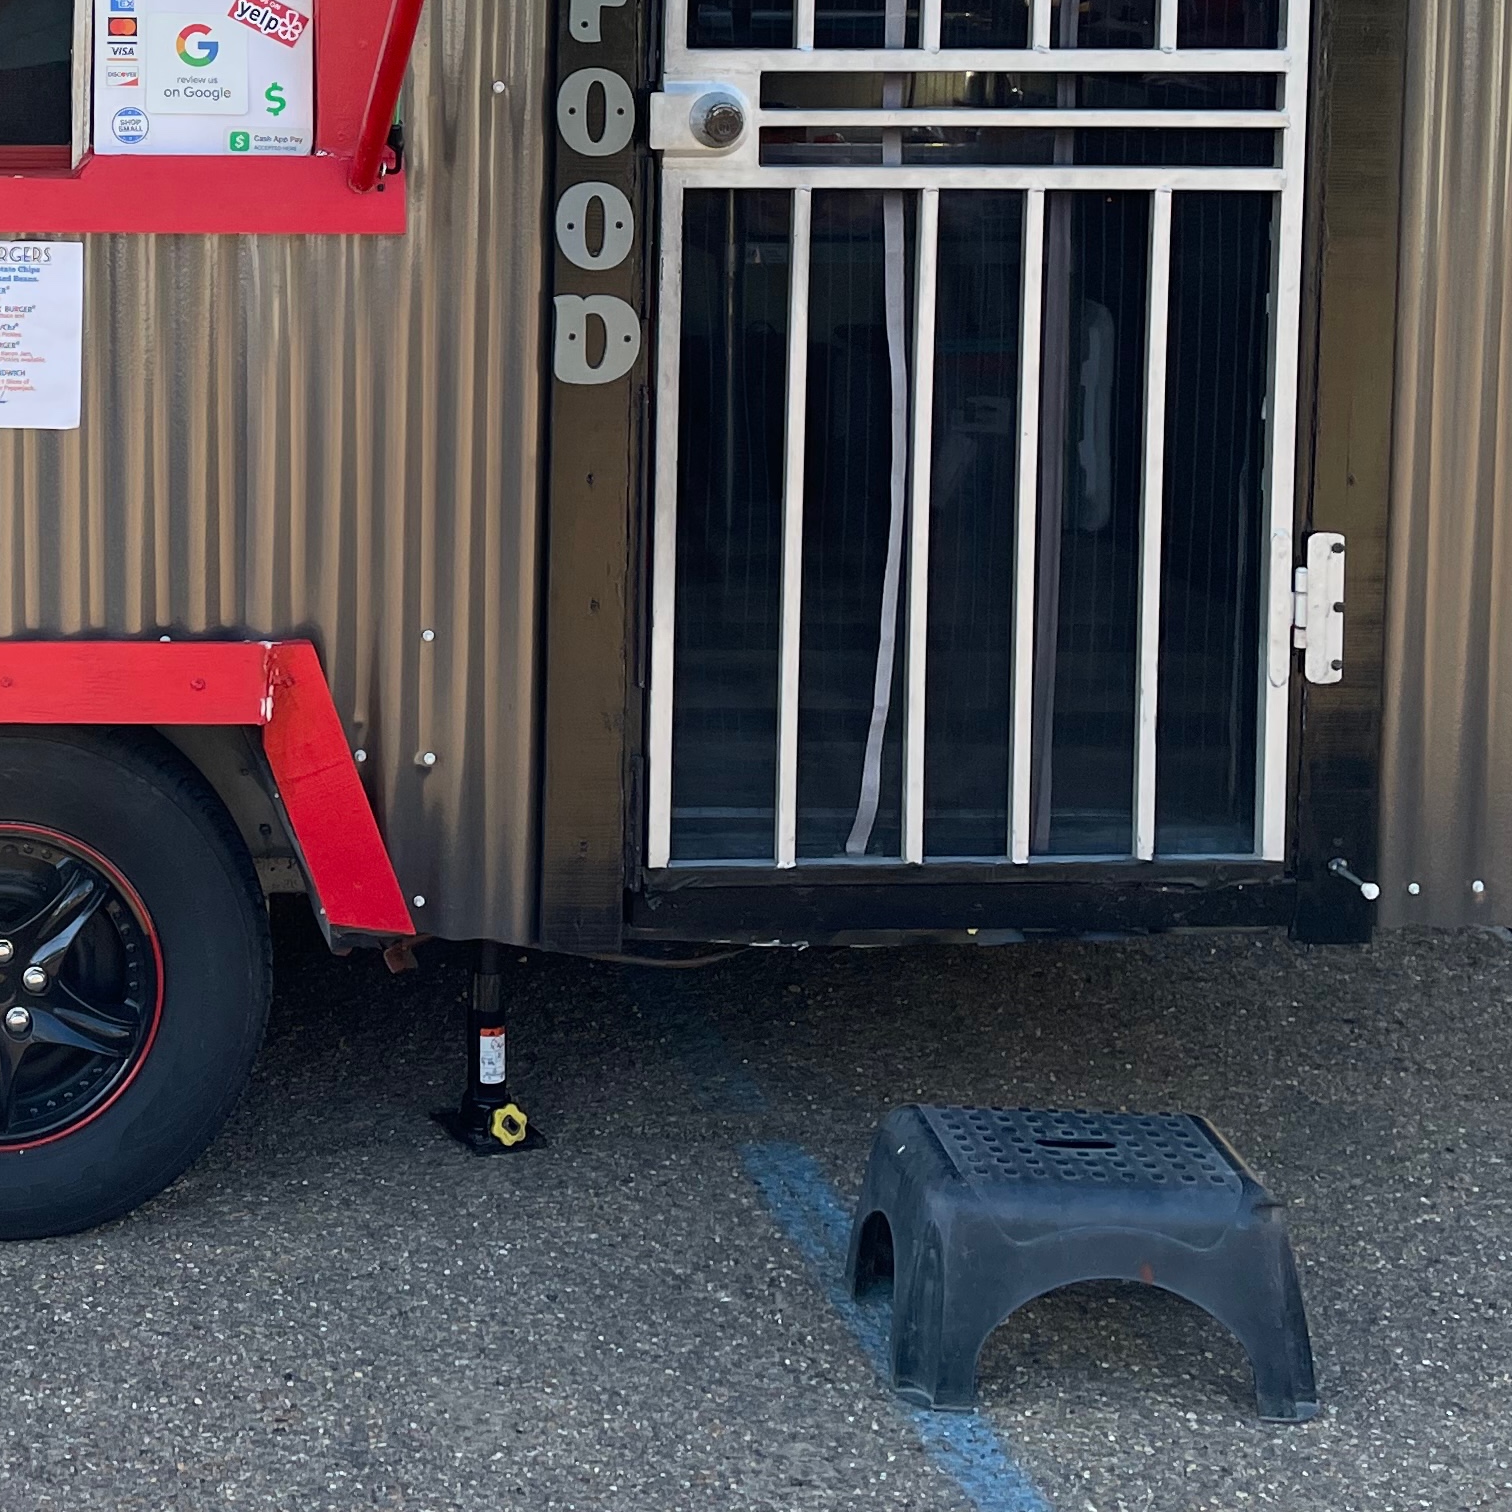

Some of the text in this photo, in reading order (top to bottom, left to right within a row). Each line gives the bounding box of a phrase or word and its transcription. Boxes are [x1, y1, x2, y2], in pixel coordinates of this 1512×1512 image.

[236, 1, 279, 31] yelp
[111, 46, 135, 56] VISA
[176, 75, 219, 84] review us
[163, 87, 232, 102] on Google
[120, 118, 141, 126] SHOP
[273, 136, 289, 144] App
[290, 136, 303, 144] Pay
[17, 266, 40, 274] Chips
